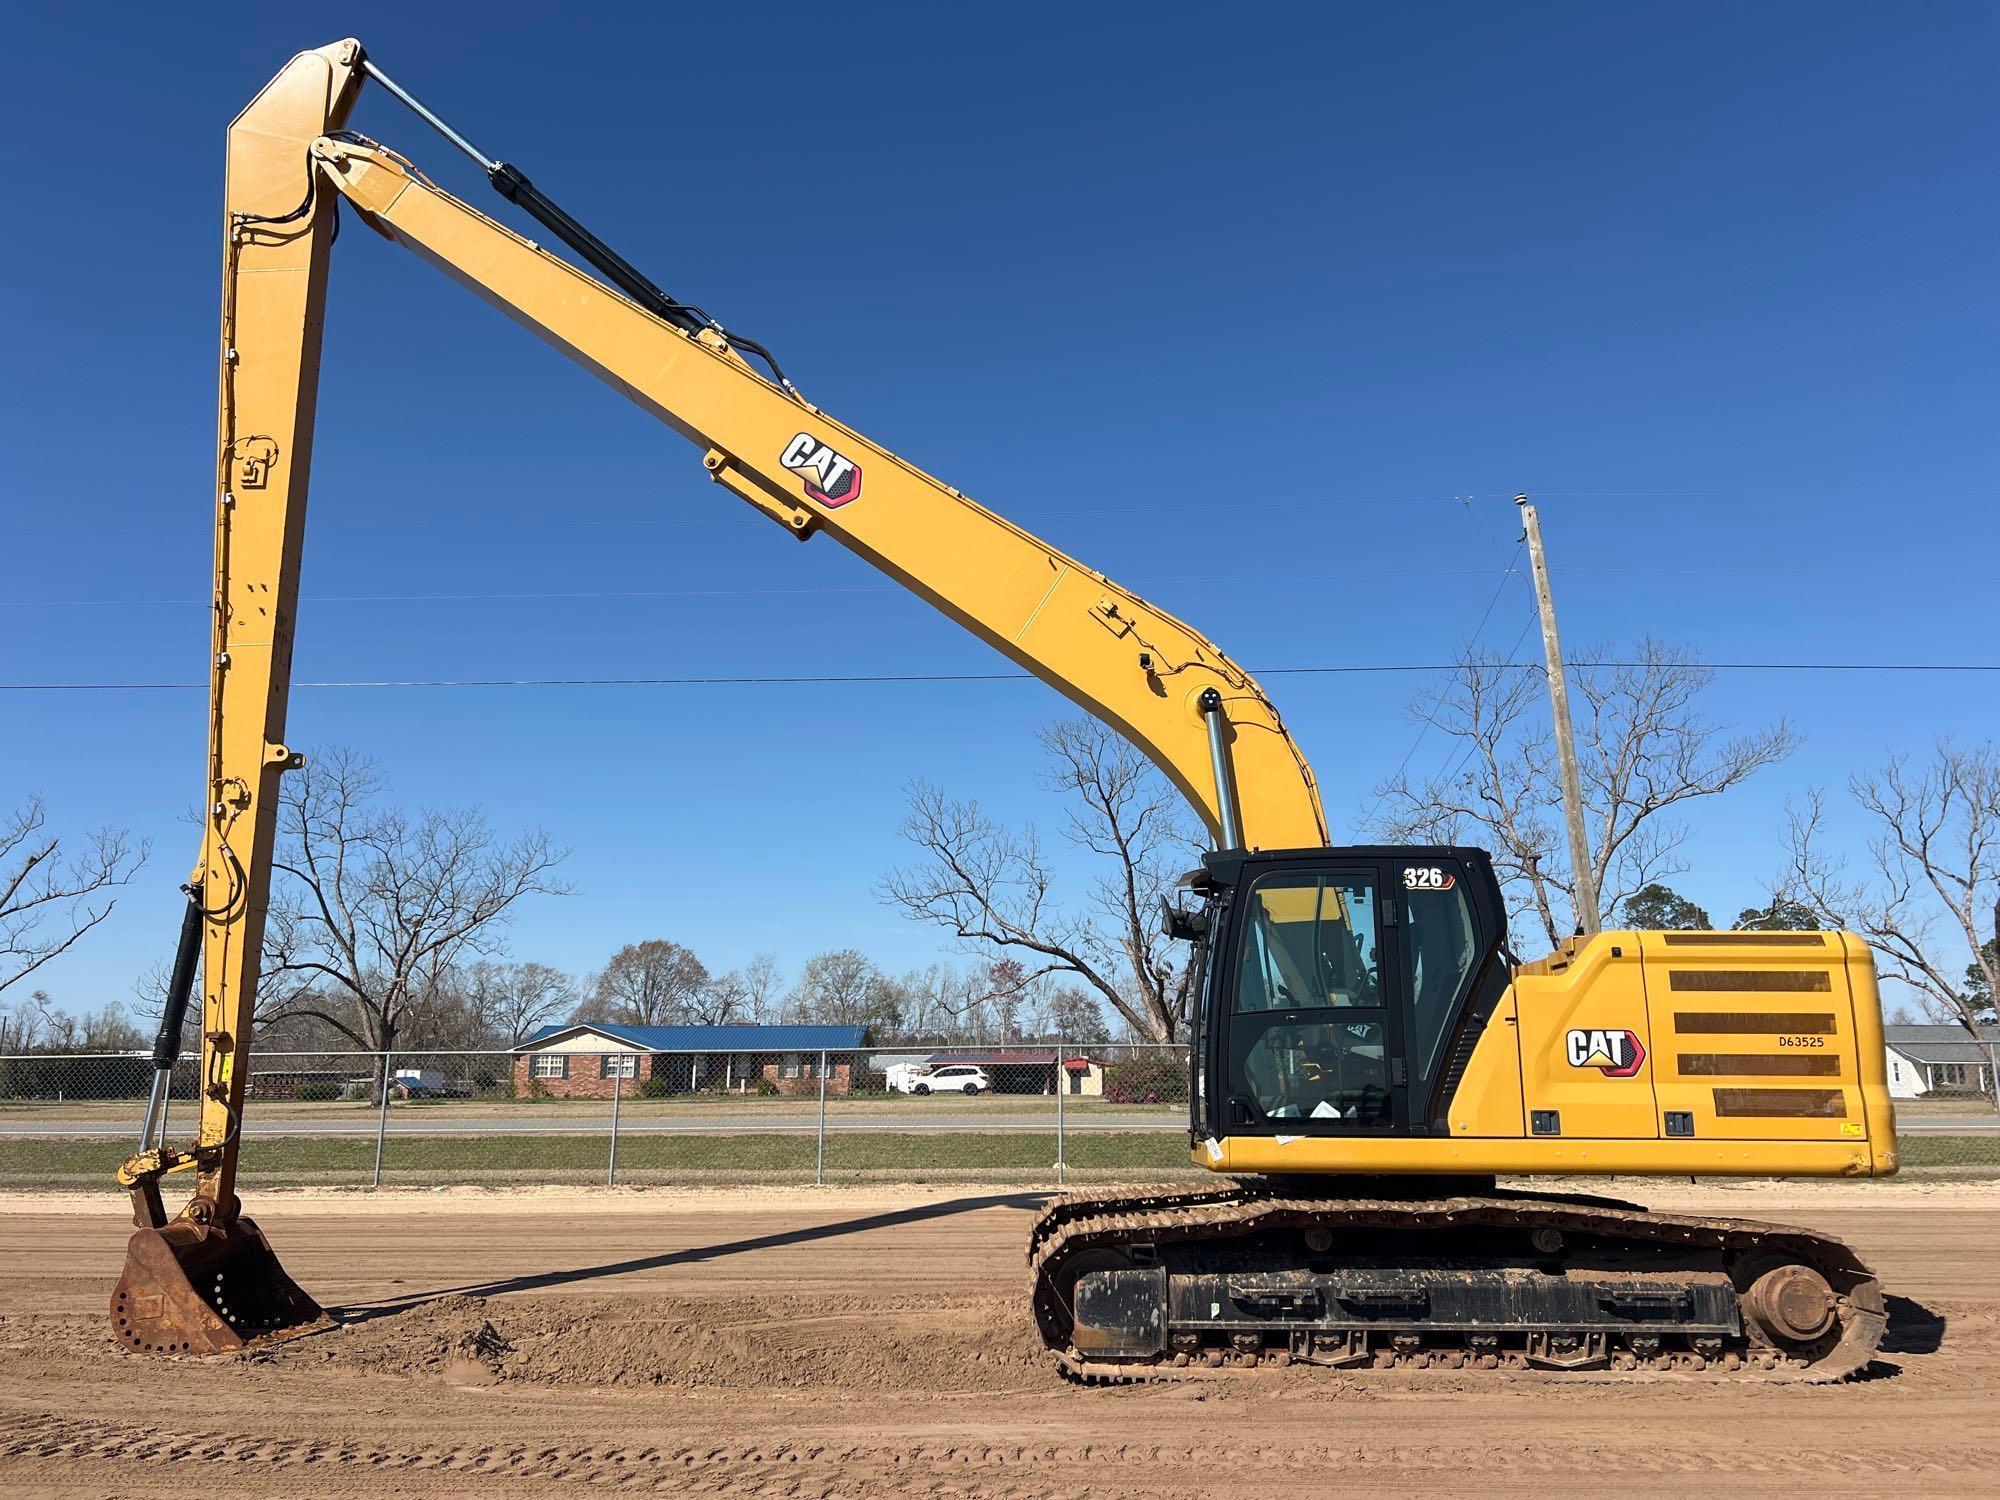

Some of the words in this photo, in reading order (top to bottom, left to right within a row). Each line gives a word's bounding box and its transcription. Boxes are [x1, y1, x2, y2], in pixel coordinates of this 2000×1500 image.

[781, 432, 855, 493] CAT
[1403, 867, 1443, 888] 326
[1567, 1030, 1626, 1067] CAT
[1779, 1036, 1825, 1048] D63525
